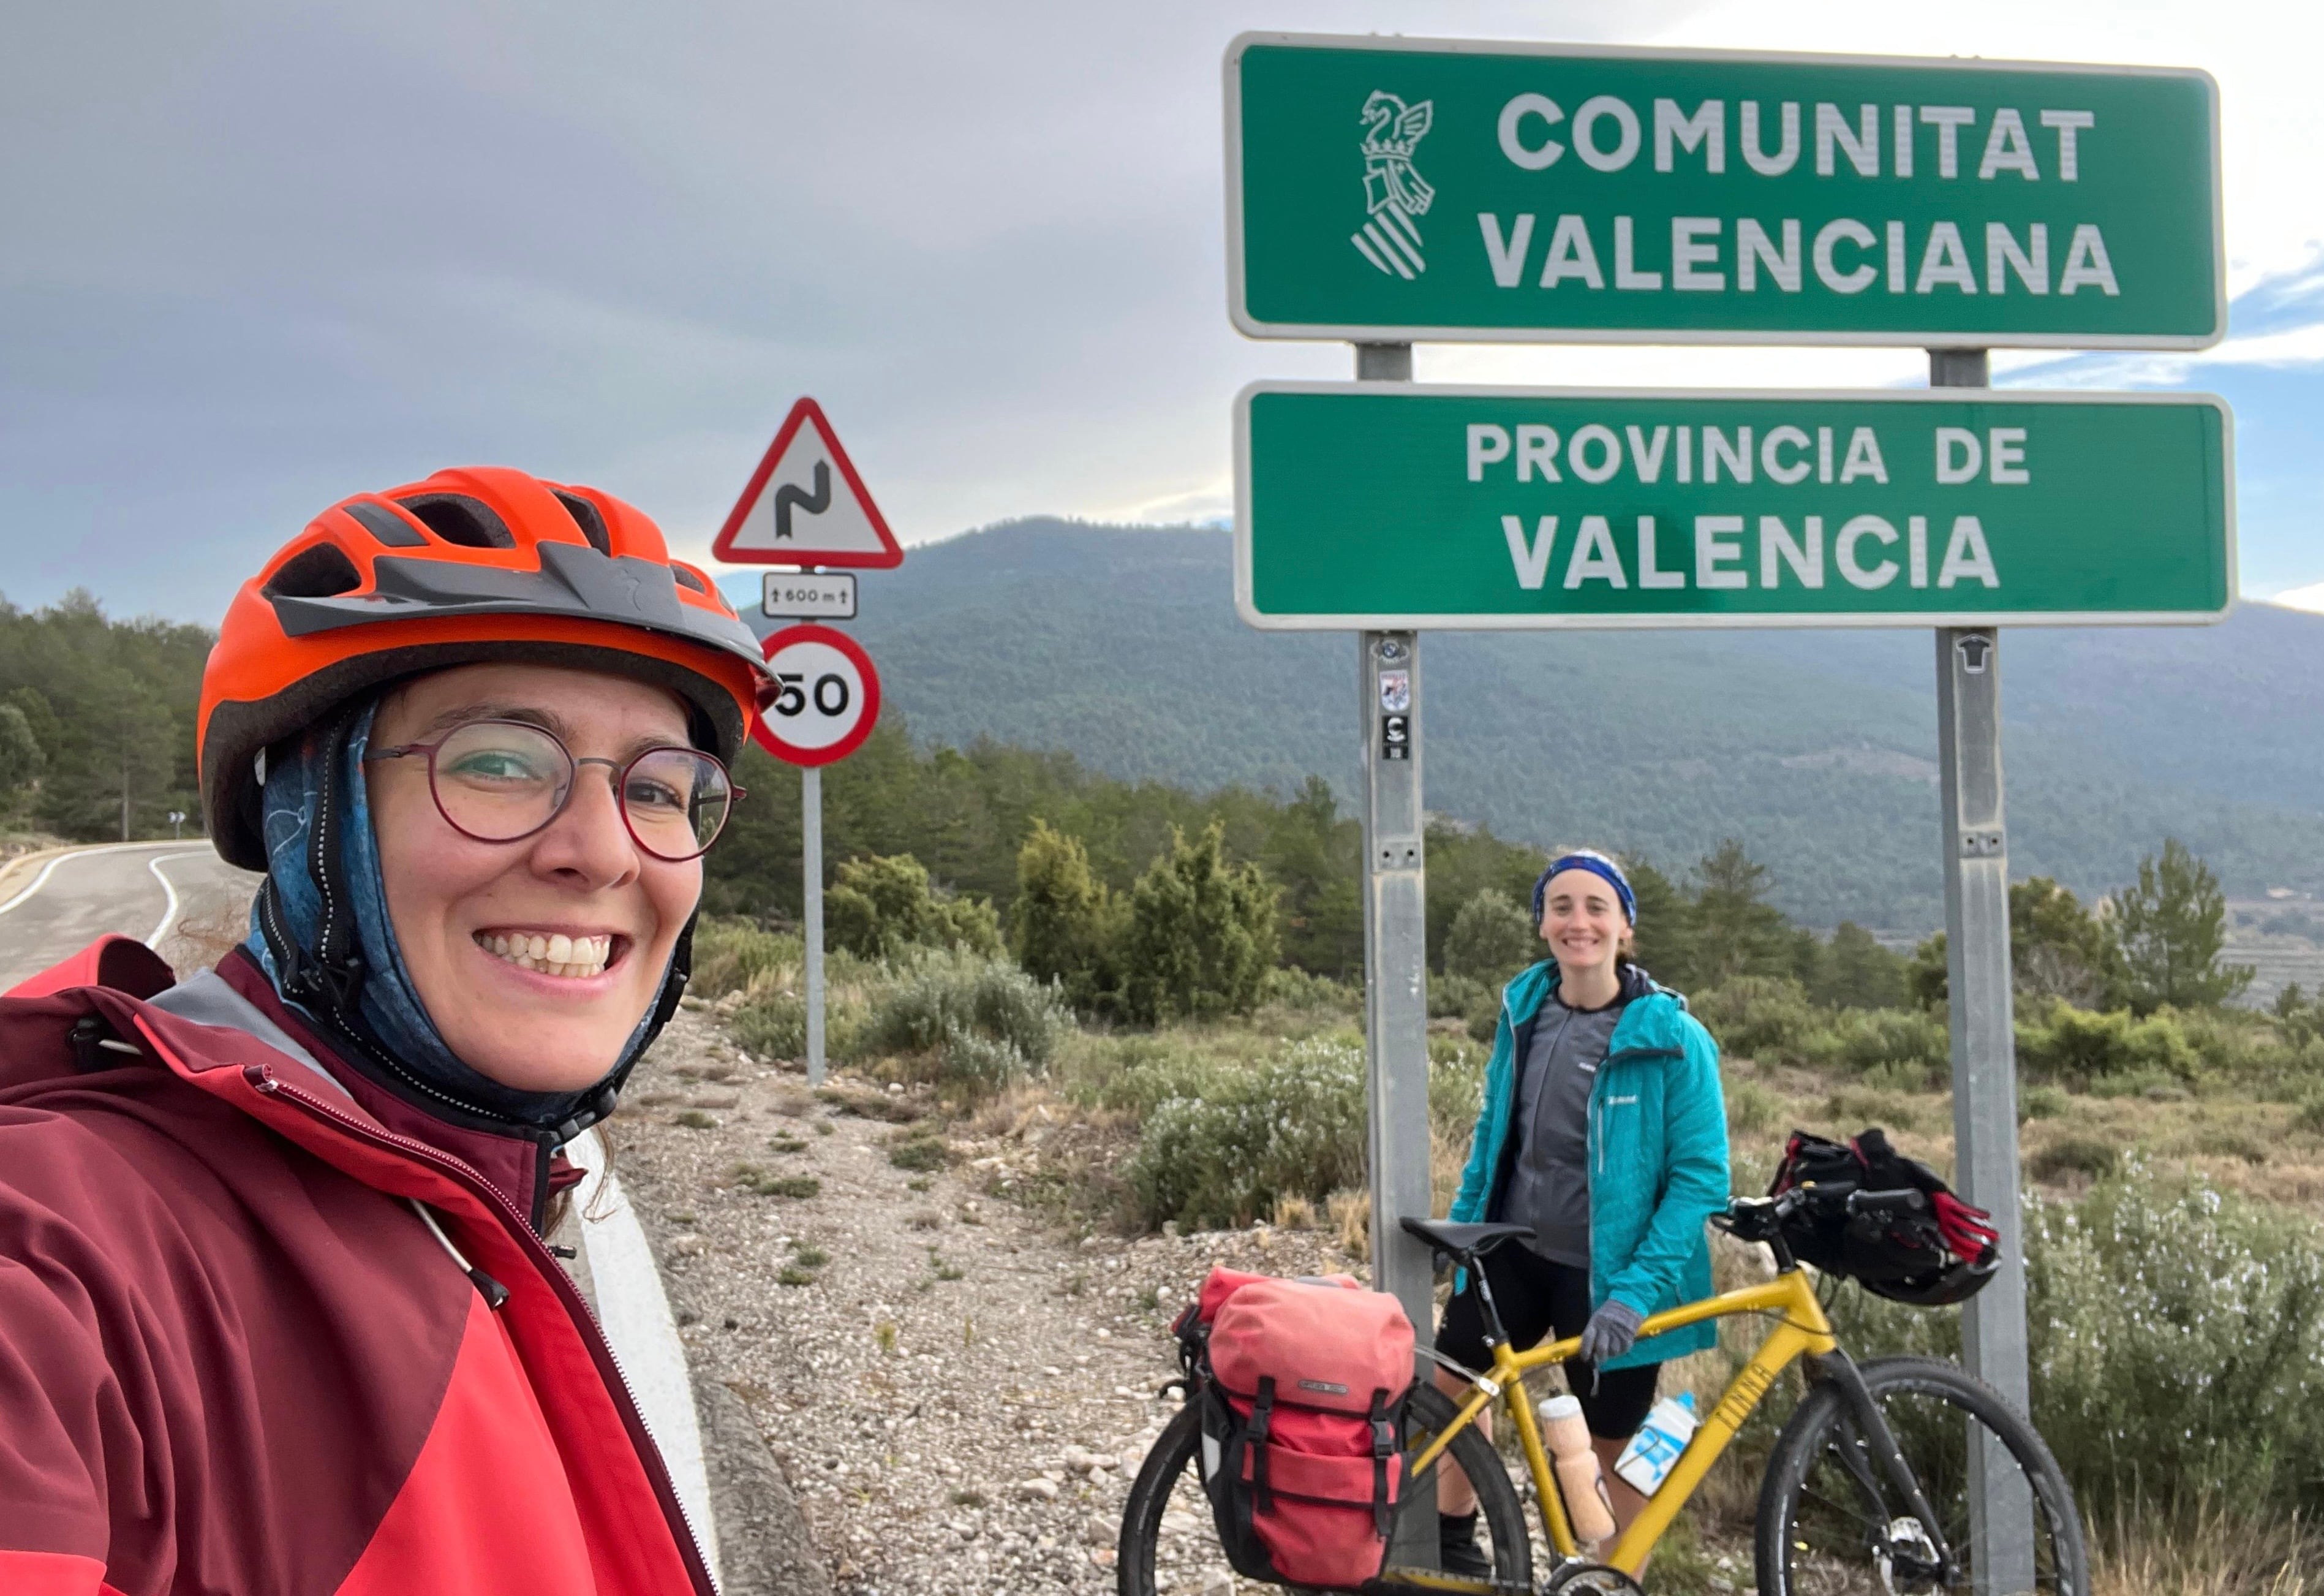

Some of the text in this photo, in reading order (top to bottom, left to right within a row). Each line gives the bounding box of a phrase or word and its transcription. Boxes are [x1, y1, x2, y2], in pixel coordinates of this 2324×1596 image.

[1498, 93, 2095, 181] COMUNITAT
[1477, 213, 2120, 297] VALENCIANA
[1466, 423, 2030, 485] PROVINCIA DE
[1501, 514, 2000, 590] VALENCIA
[786, 589, 835, 602] 600 m
[775, 673, 849, 717] 50
